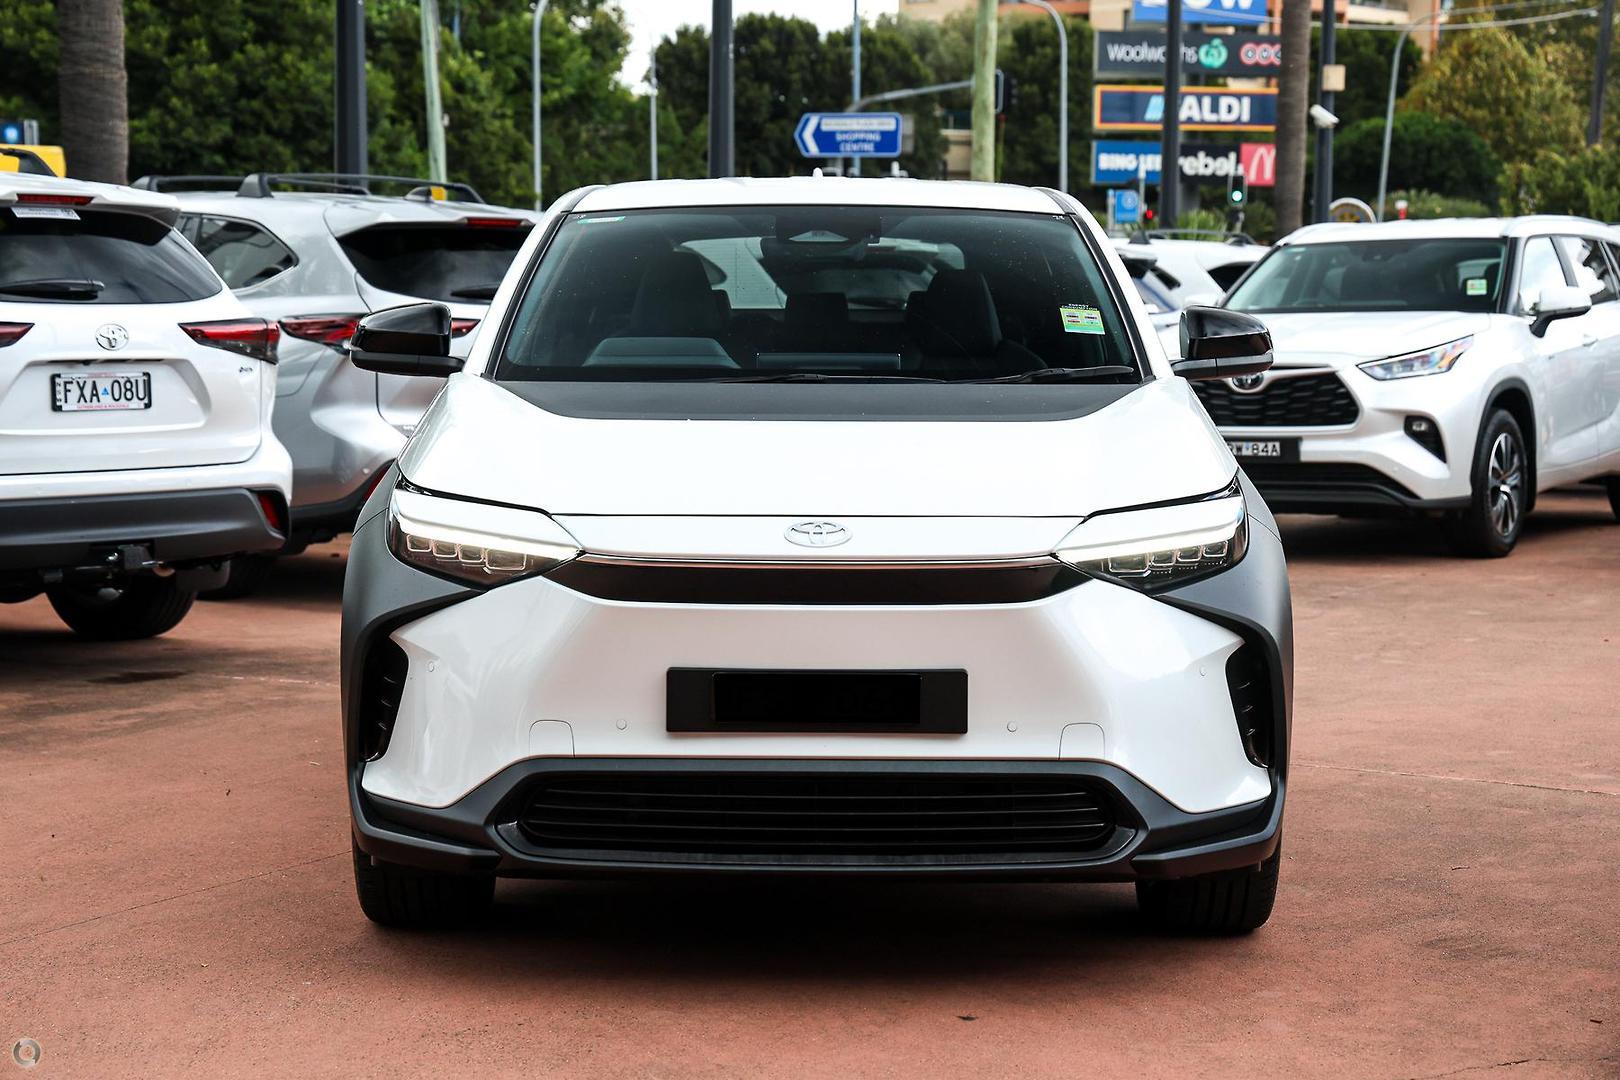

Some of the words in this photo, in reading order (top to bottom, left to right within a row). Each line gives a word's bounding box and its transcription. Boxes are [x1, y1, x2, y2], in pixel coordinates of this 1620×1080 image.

[1178, 95, 1251, 122] ALDI
[63, 380, 101, 404] FXA
[110, 378, 147, 402] 08U
[1251, 442, 1279, 456] 84A
